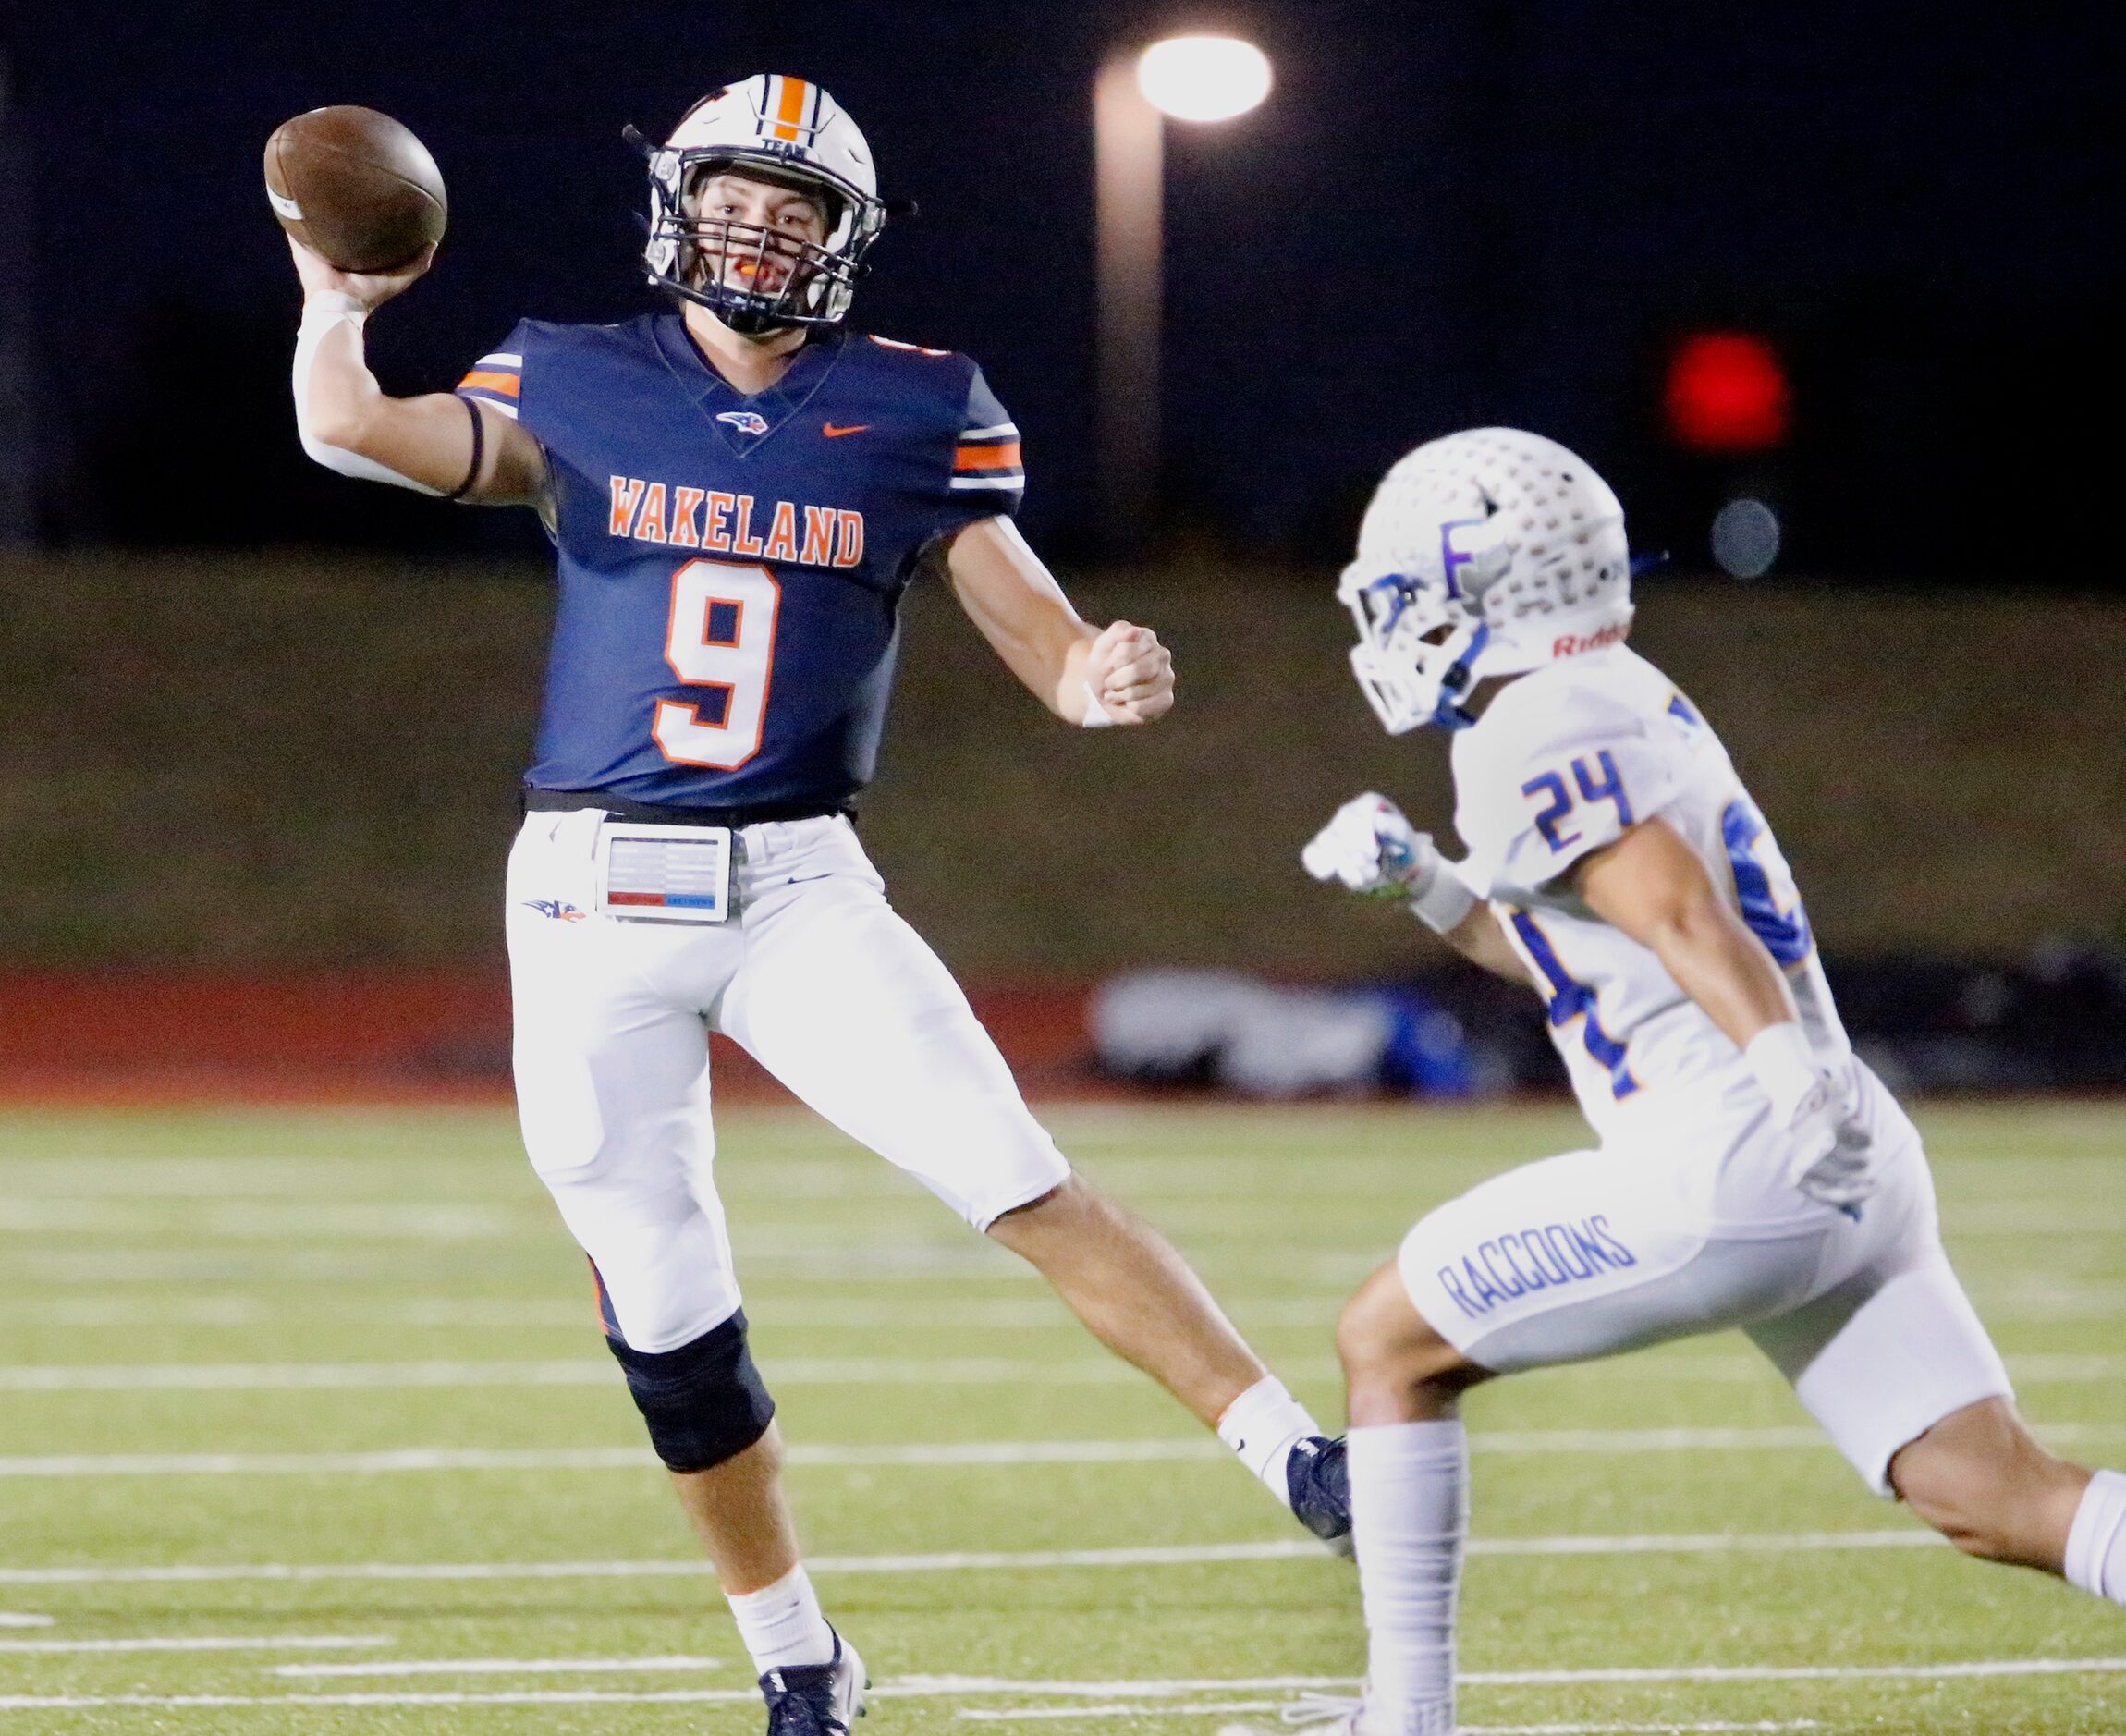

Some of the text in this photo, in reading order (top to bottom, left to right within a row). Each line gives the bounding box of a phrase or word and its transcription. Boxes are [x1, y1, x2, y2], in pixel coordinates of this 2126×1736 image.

[762, 138, 808, 160] TEAM
[609, 474, 864, 568] WAKELAND
[1440, 519, 1485, 601] F
[651, 556, 782, 773] 9
[1521, 749, 1633, 855] 24
[1437, 1214, 1637, 1319] RACCOONS
